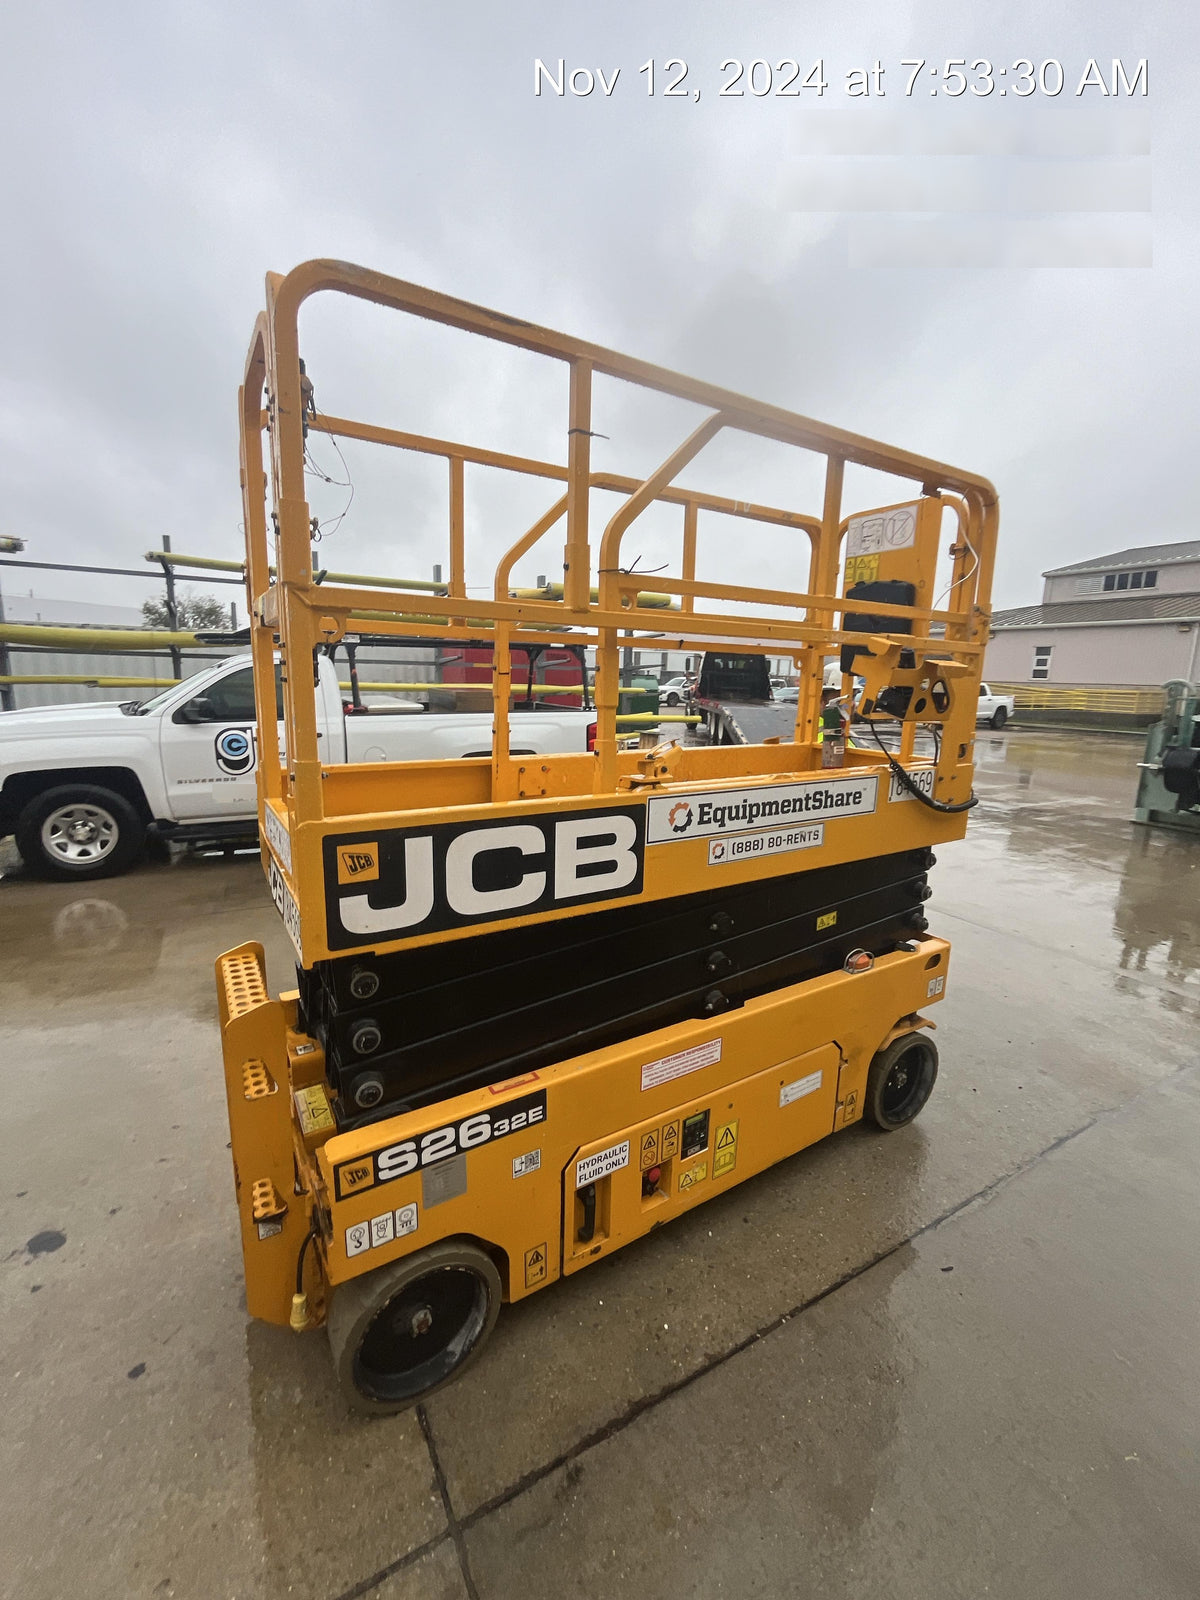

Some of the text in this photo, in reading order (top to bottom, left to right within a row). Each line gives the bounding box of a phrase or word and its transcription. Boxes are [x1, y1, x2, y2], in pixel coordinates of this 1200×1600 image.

[697, 789, 862, 828] EquipmentShare
[731, 829, 820, 856] (888) 80-RENTS
[339, 815, 638, 934] JCB
[347, 852, 374, 873] JCB
[578, 1144, 628, 1172] HYDRAULIC
[578, 1155, 627, 1184] FLUID ONLY
[348, 1168, 370, 1186] JCB
